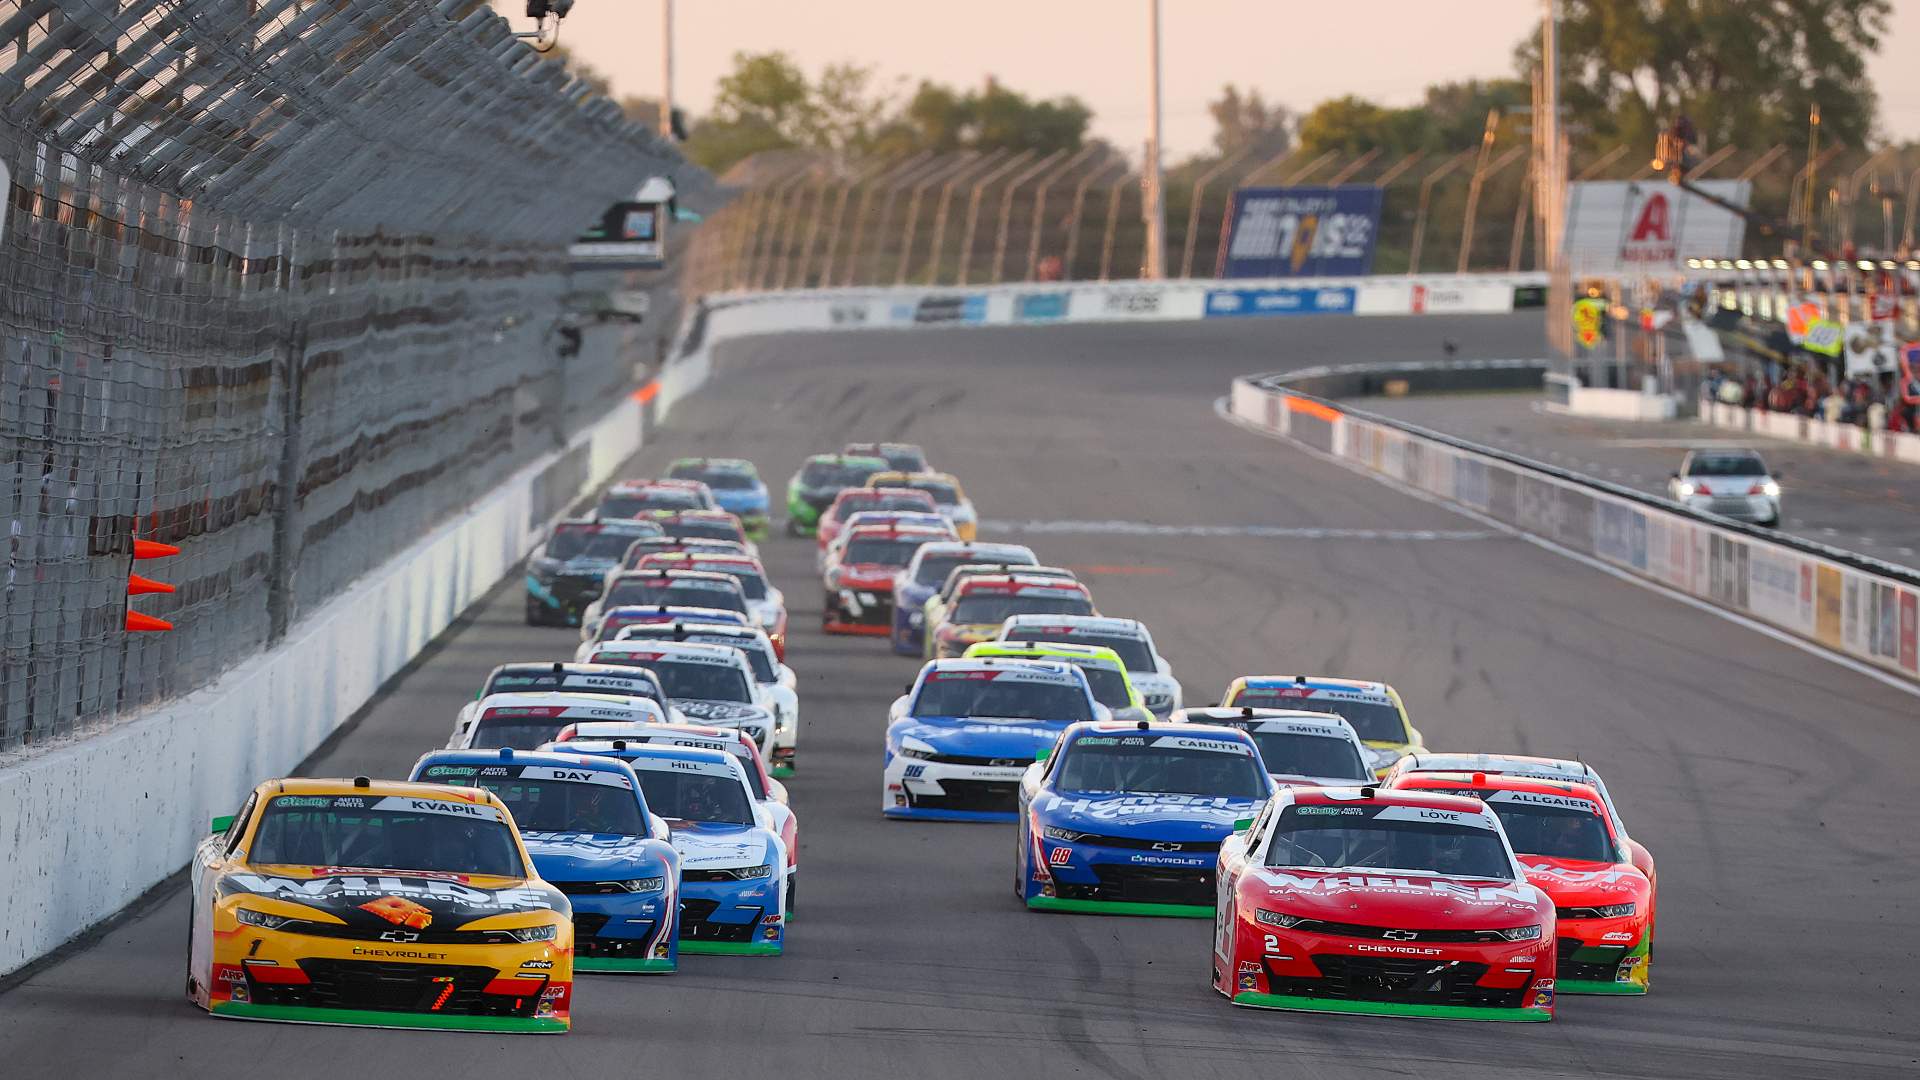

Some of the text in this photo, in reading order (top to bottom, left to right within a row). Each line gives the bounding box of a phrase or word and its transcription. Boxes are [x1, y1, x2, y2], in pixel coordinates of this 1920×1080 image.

[586, 677, 633, 688] MAYER
[1328, 691, 1388, 703] SANCHEZ
[590, 708, 633, 718] CREWS
[1287, 724, 1332, 735] SMITH
[674, 740, 723, 751] CREED
[1178, 739, 1239, 751] CARUTH
[672, 760, 702, 771] HILL
[553, 770, 593, 781] DAY
[1511, 793, 1591, 809] ALLGAIER
[411, 800, 483, 816] KVAPIL
[1420, 810, 1459, 822] LOVE
[1050, 846, 1073, 865] 88
[1131, 855, 1205, 866] CHEVROLET
[229, 874, 552, 910] WILDE
[1253, 872, 1538, 904] WHELEN
[279, 889, 382, 900] PROTEIN
[1269, 886, 1423, 897] MANUFACTURED
[1454, 896, 1538, 913] AMERICA
[249, 938, 264, 956] 1
[1264, 934, 1280, 953] 2
[352, 948, 447, 960] CHEVROLET
[1358, 944, 1443, 955] CHEVROLET
[522, 961, 553, 969] JRM
[1240, 961, 1262, 972] ARP
[220, 969, 244, 980] ARP
[1534, 978, 1554, 989] ARP
